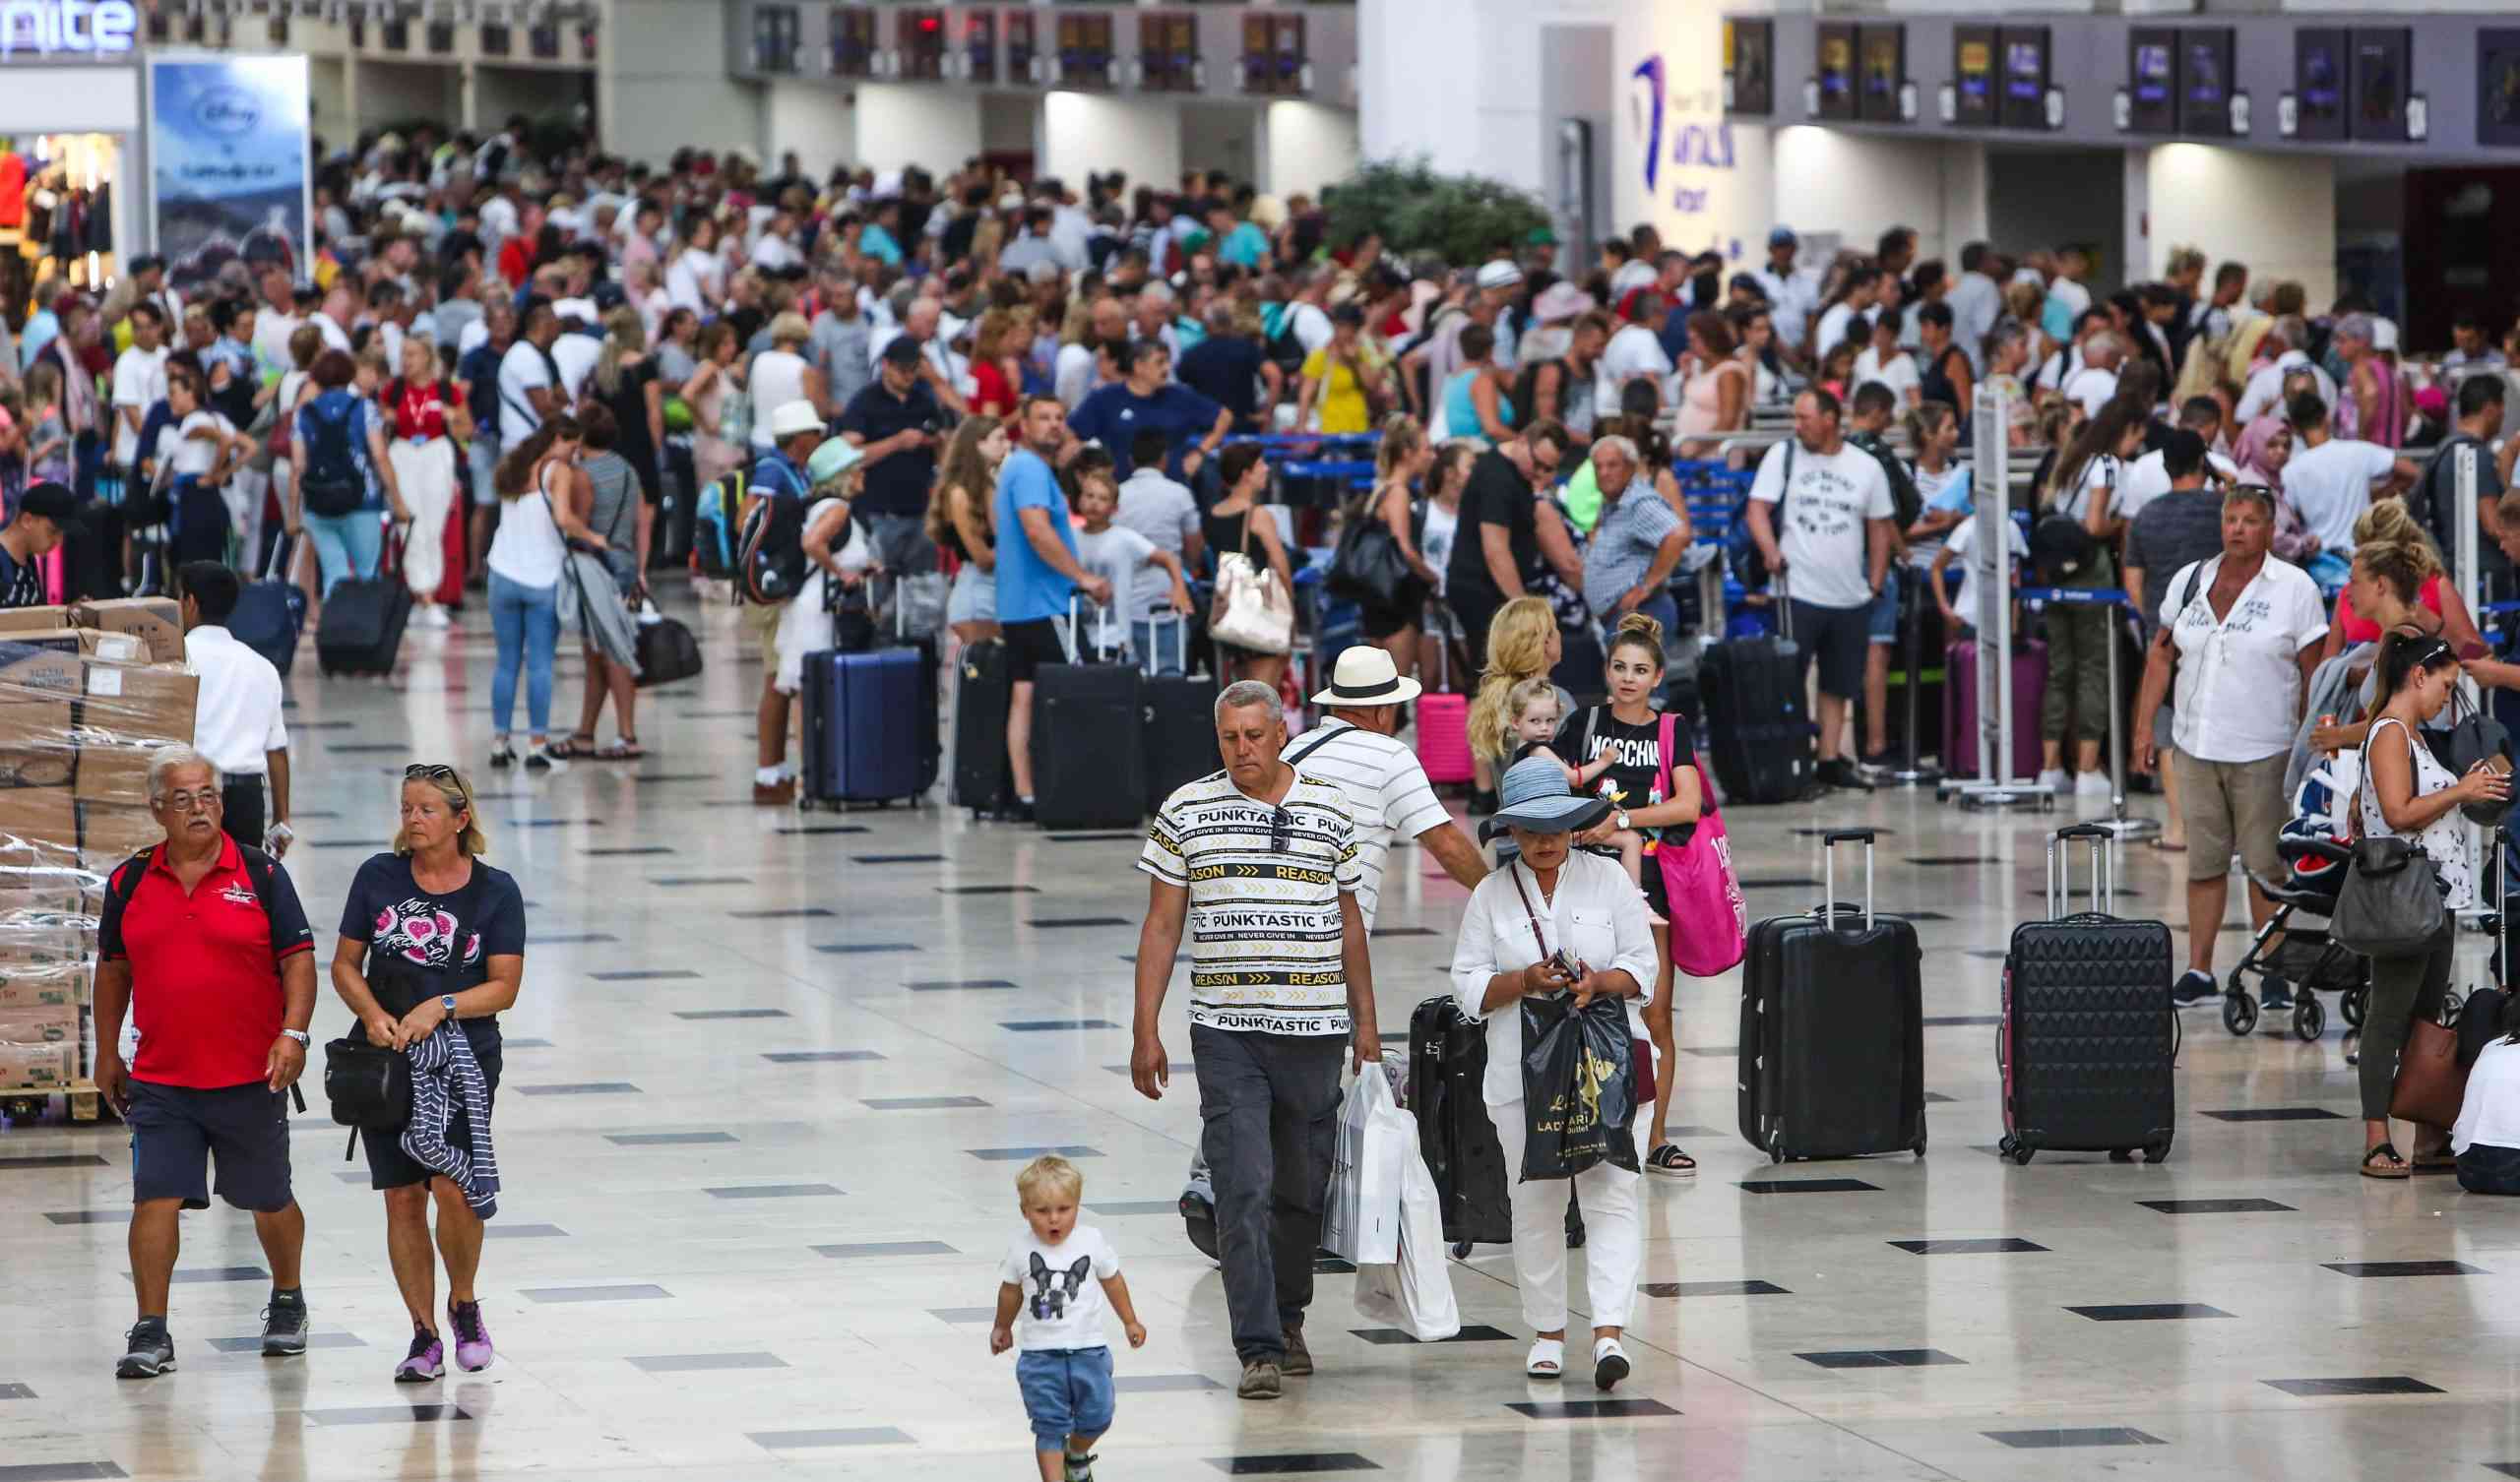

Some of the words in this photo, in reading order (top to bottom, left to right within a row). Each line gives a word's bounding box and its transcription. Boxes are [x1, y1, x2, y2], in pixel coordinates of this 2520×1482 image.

[1276, 865, 1332, 885] REASON
[1213, 914, 1316, 928] PUNKTASTIC
[1289, 972, 1340, 985] REASON
[1217, 1015, 1321, 1032] PUNKTASTIC
